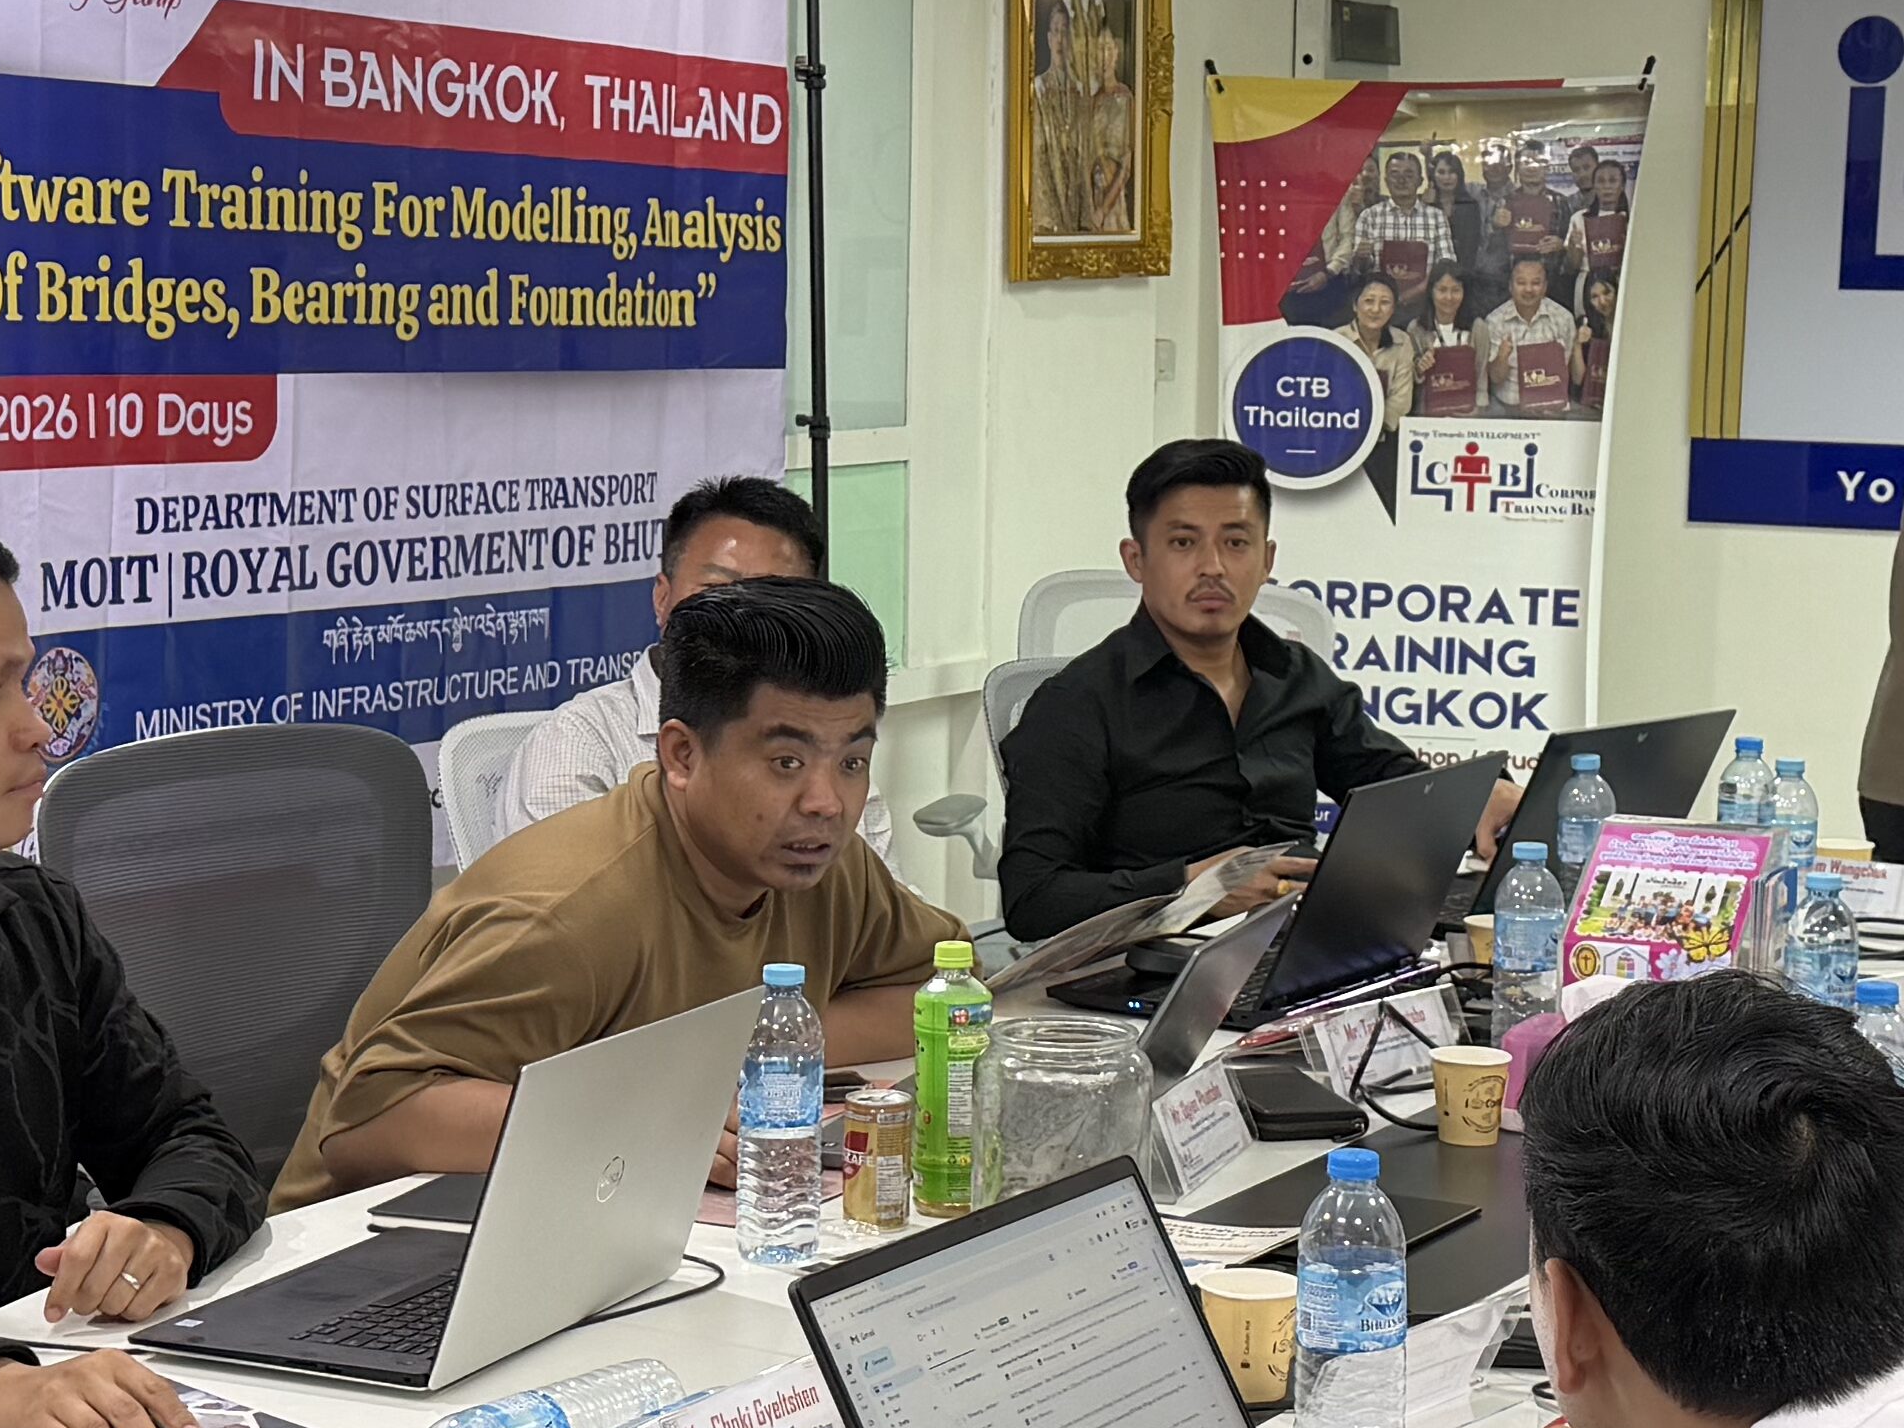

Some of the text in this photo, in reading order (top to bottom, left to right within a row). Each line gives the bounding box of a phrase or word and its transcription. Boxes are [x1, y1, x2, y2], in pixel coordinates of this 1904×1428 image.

[253, 39, 783, 145] IN BANGKOK, THAILAND
[162, 166, 363, 251] Training
[372, 181, 444, 239] For
[449, 184, 638, 261] Modelling,
[642, 196, 782, 262] Analysis
[35, 255, 241, 340] Bridges,
[250, 263, 421, 341] Bearing
[427, 269, 499, 327] and
[107, 392, 143, 438] 10
[158, 393, 253, 446] Days
[1244, 406, 1360, 429] Thailand
[1276, 376, 1331, 398] CTB
[134, 472, 658, 537] DEPARTMENT OF SURFACE TRANSPORT
[41, 554, 159, 612] MOIT
[182, 544, 318, 601] ROYAL
[136, 696, 264, 739] MINISTRY
[271, 692, 301, 724] OF
[312, 669, 519, 720] INFRASTRUCTURE
[523, 663, 560, 691] AND
[753, 1385, 820, 1426] Gyeltshen
